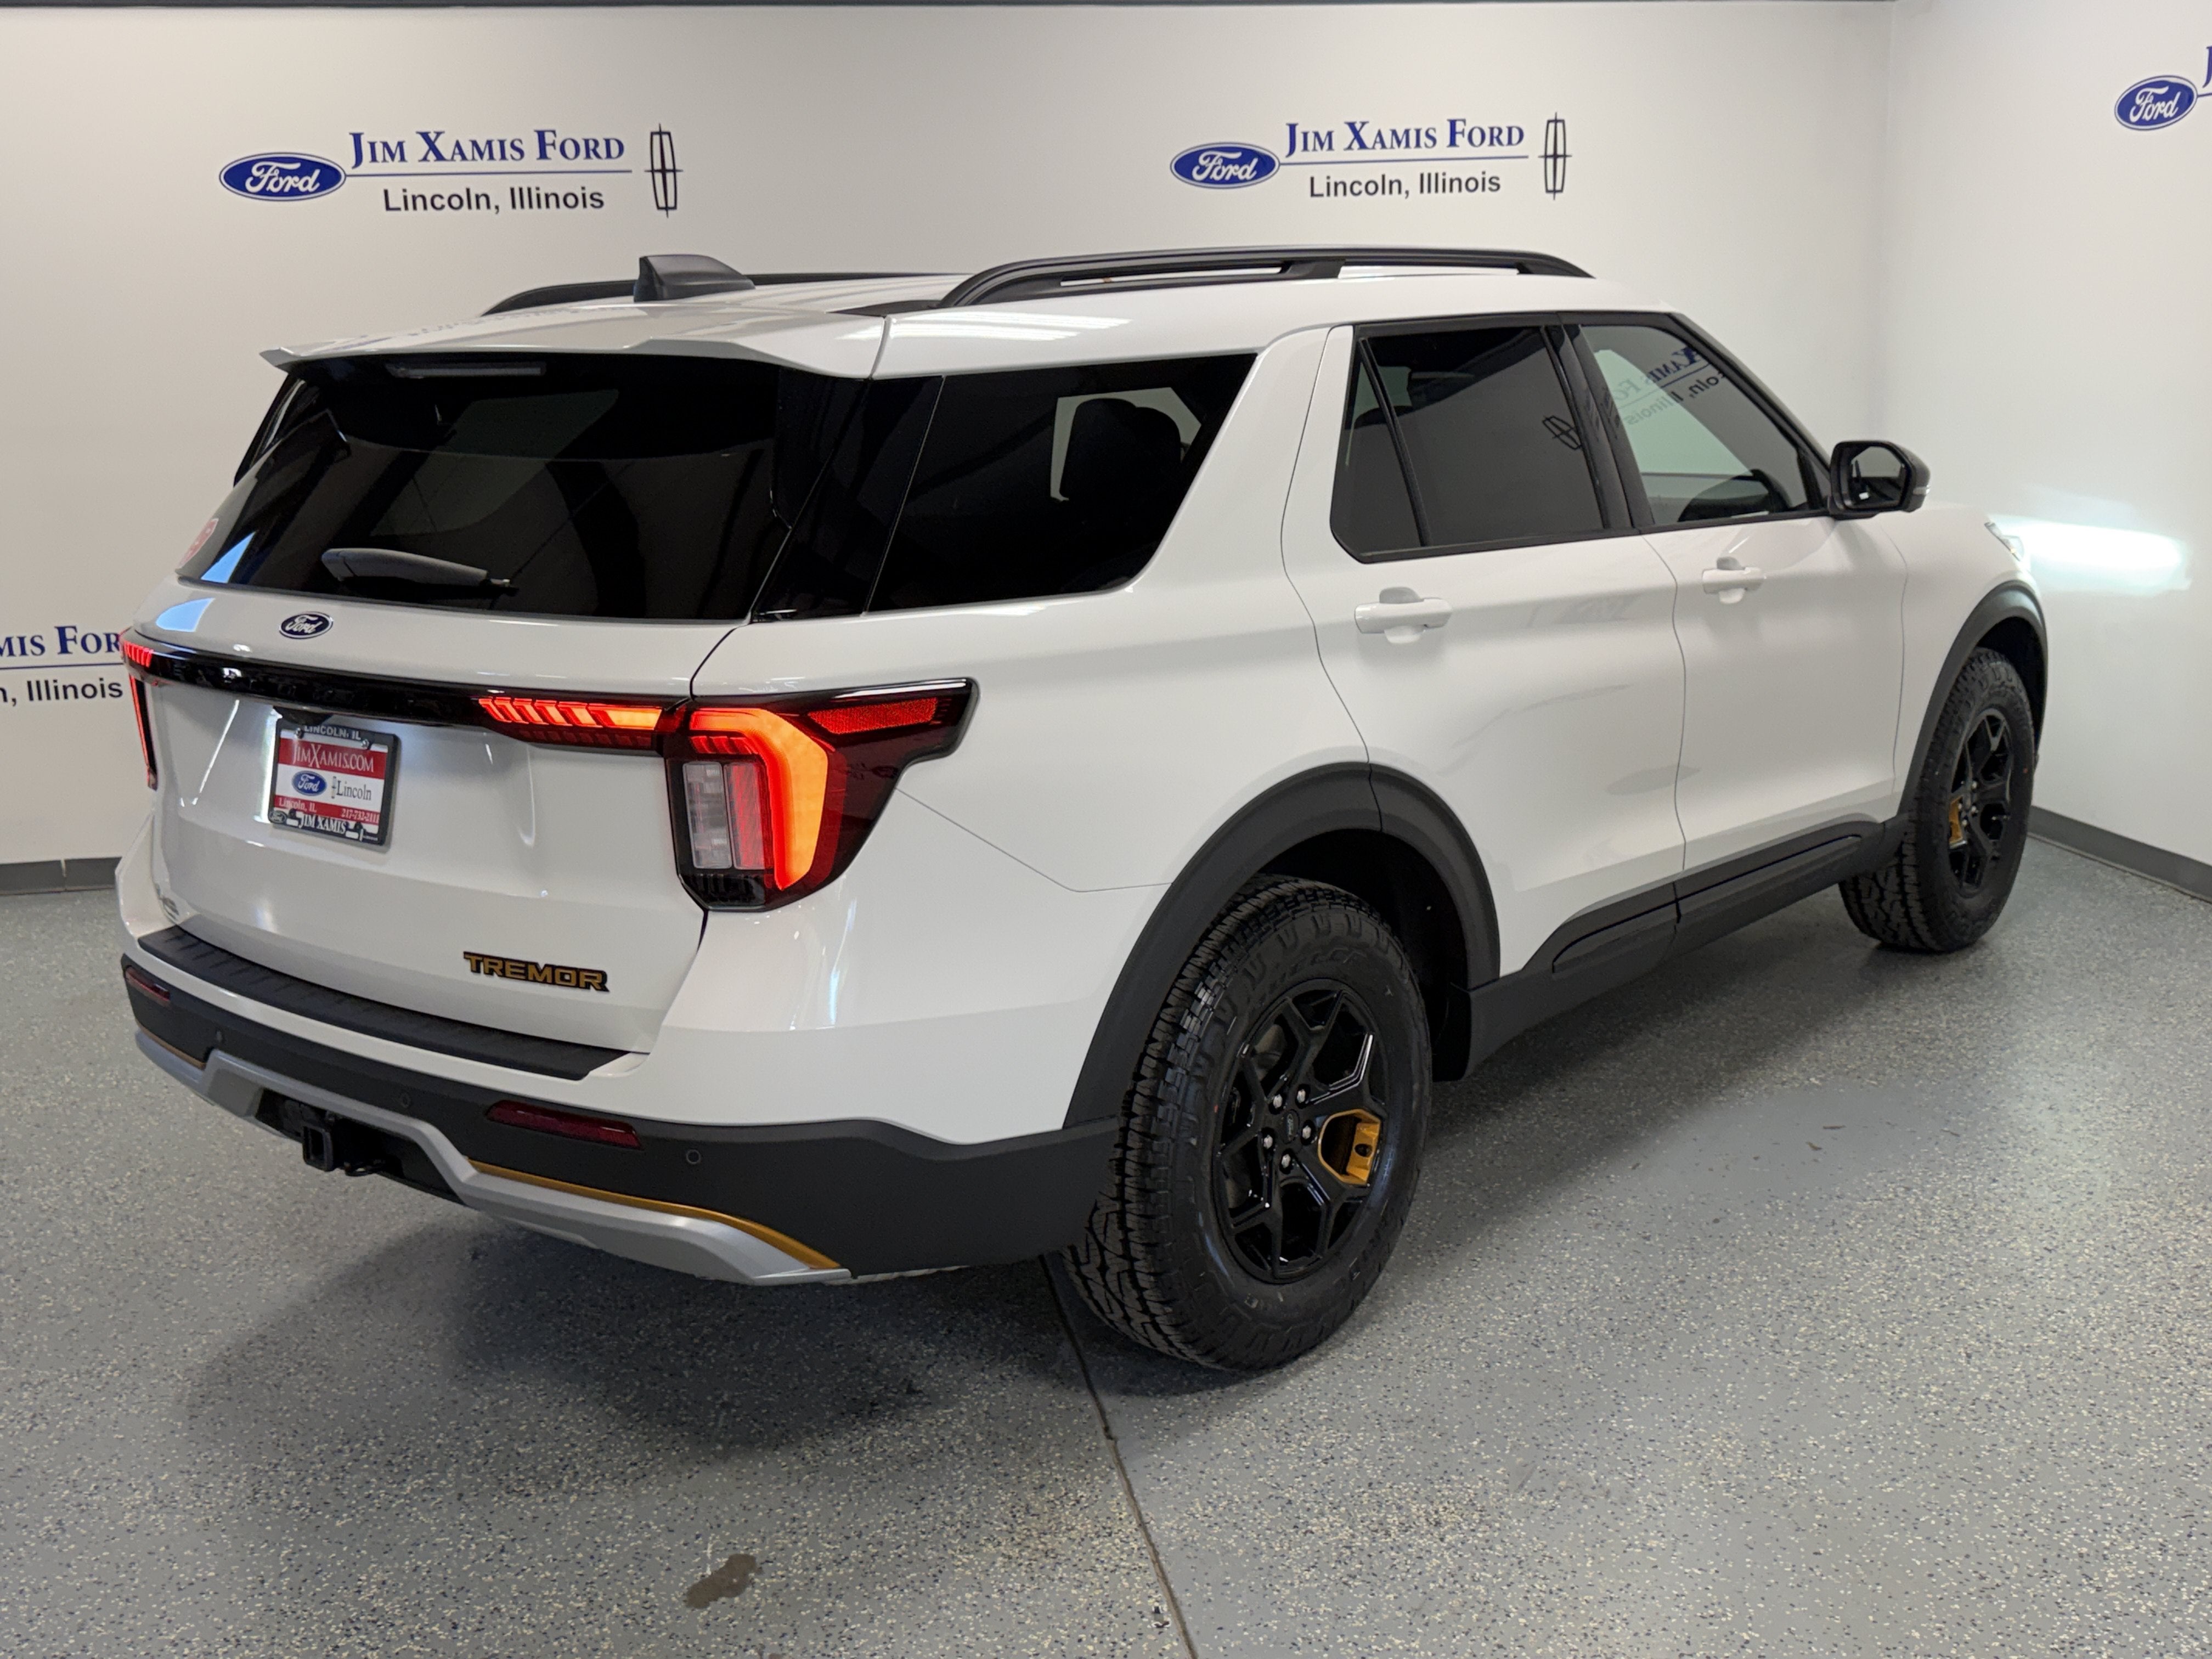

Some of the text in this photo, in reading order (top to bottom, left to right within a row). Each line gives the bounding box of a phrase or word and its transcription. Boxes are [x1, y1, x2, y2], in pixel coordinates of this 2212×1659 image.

[2129, 86, 2181, 123] Ford
[349, 129, 624, 169] JIM XAMIS FORD
[1285, 119, 1525, 158] JIM XAMIS FORD
[245, 161, 321, 193] Ford
[1192, 151, 1257, 181] Ford
[1310, 172, 1501, 199] Lincoln, Illinois
[383, 186, 605, 213] Lincoln, Illinois
[285, 614, 323, 634] Ford
[54, 625, 120, 655] FOR
[27, 678, 123, 701] Illinois
[352, 730, 362, 741] IL
[298, 774, 320, 793] Ford
[337, 780, 372, 801] Lincoln
[298, 814, 347, 835] JIM XAMIS
[463, 951, 610, 992] TREMOR
